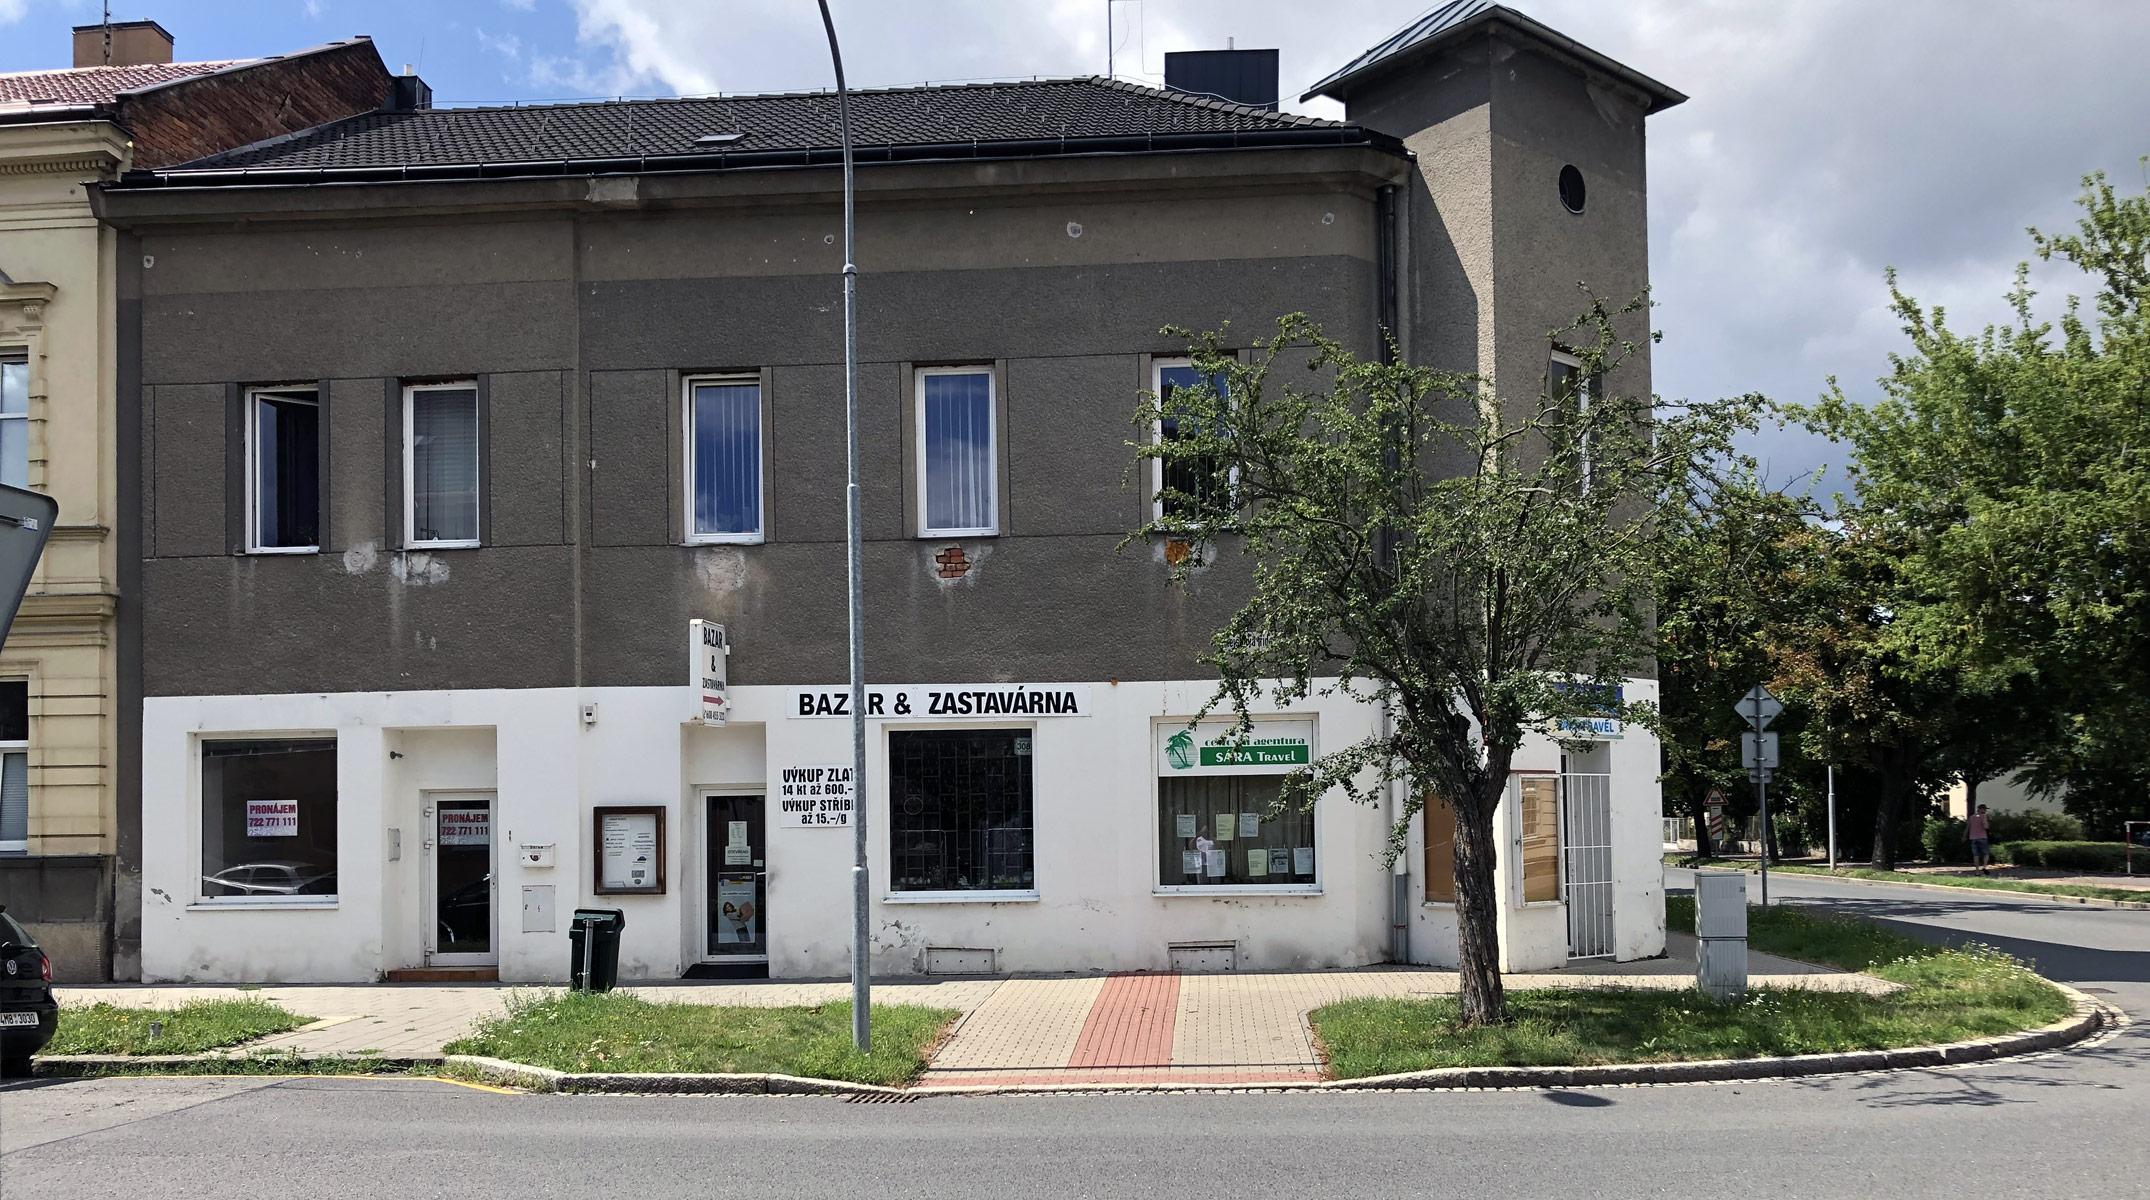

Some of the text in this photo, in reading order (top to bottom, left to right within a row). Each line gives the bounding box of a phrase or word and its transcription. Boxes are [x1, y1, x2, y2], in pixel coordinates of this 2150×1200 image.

[703, 626, 723, 650] BAZAR
[711, 654, 717, 673] &
[799, 685, 1079, 716] BAZR & ZASTAVÁRNA
[1253, 737, 1305, 748] agentura
[1215, 748, 1253, 763] SÁRA
[782, 766, 824, 783] VÝKUP
[782, 784, 794, 796] 14
[810, 783, 822, 795] až
[249, 802, 297, 815] PRONÁJEM
[782, 797, 817, 812] VÝKUP
[249, 816, 296, 828] 722 771 111
[442, 811, 489, 824] PRONÁJEM
[801, 812, 813, 825] až
[441, 826, 489, 836] 722 771 111
[17, 1013, 36, 1024] 3030
